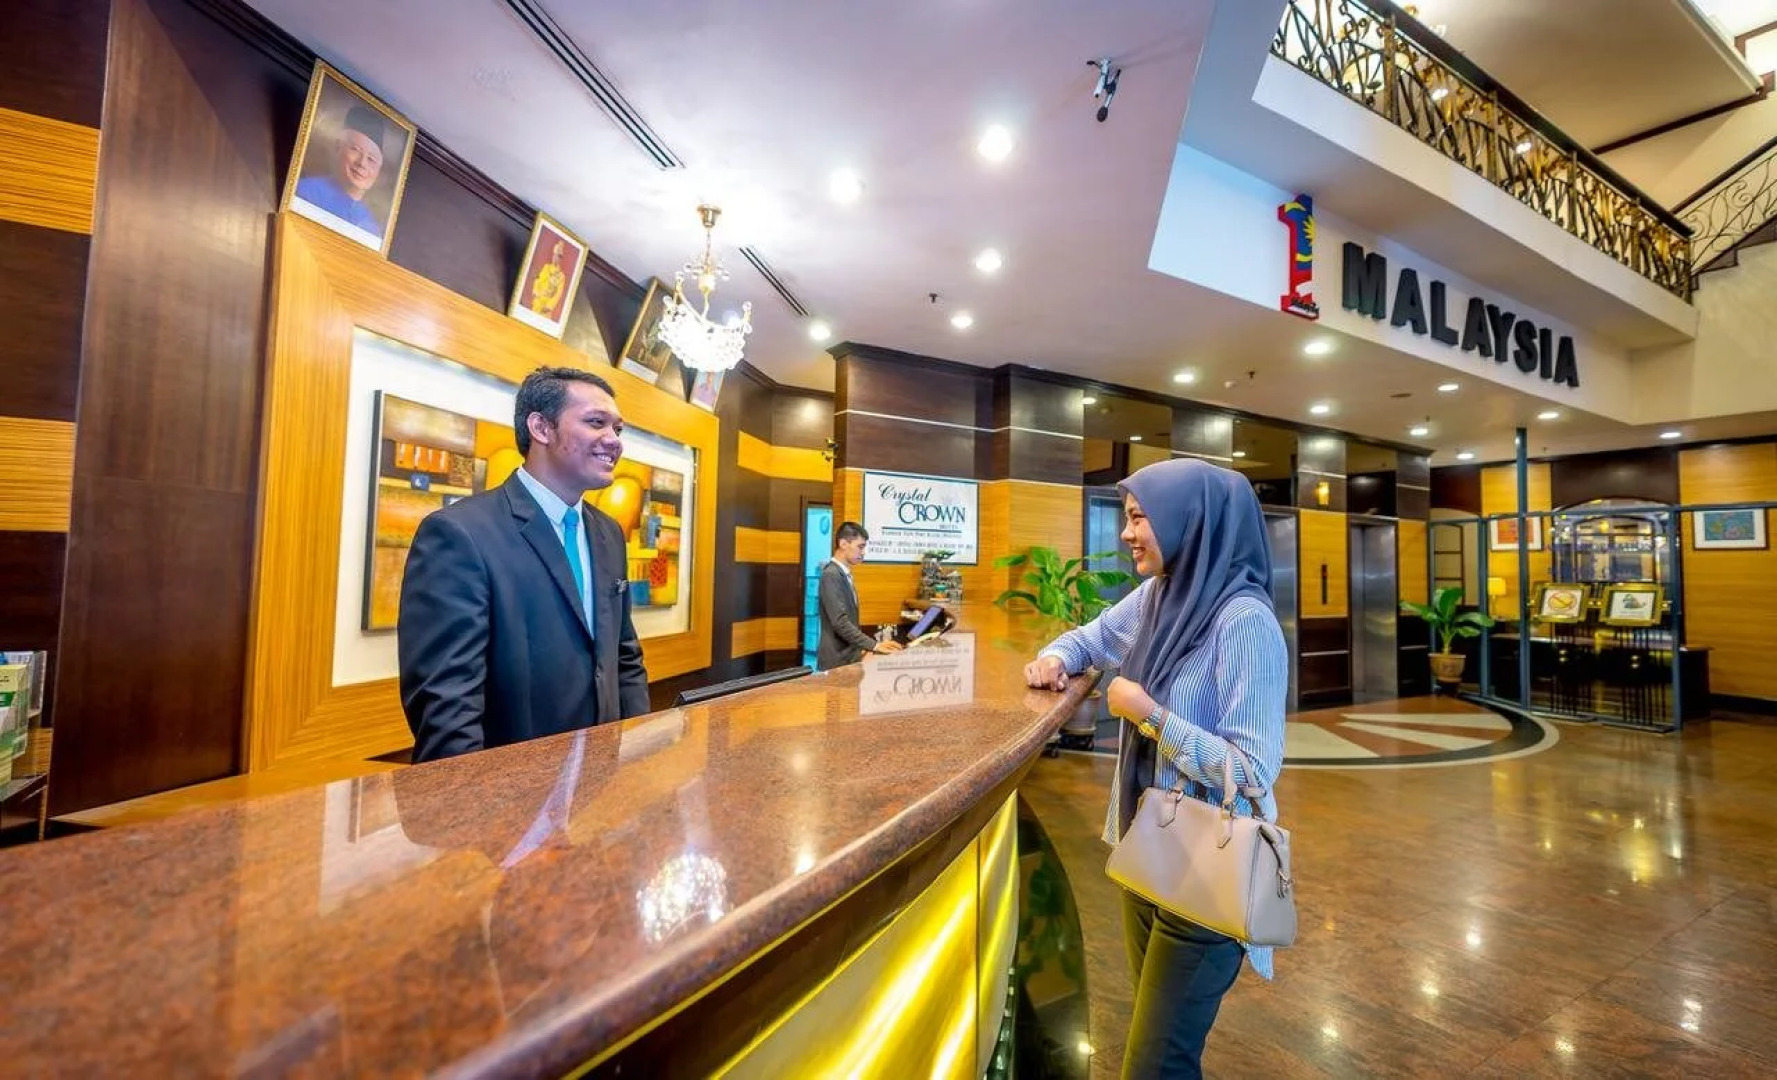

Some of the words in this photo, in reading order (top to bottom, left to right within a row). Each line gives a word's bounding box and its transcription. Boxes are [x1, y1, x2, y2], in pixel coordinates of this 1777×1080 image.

[1277, 193, 1319, 320] 1
[1341, 241, 1580, 387] MALAYSIA
[878, 483, 932, 503] Crystal
[898, 501, 966, 524] CROWN
